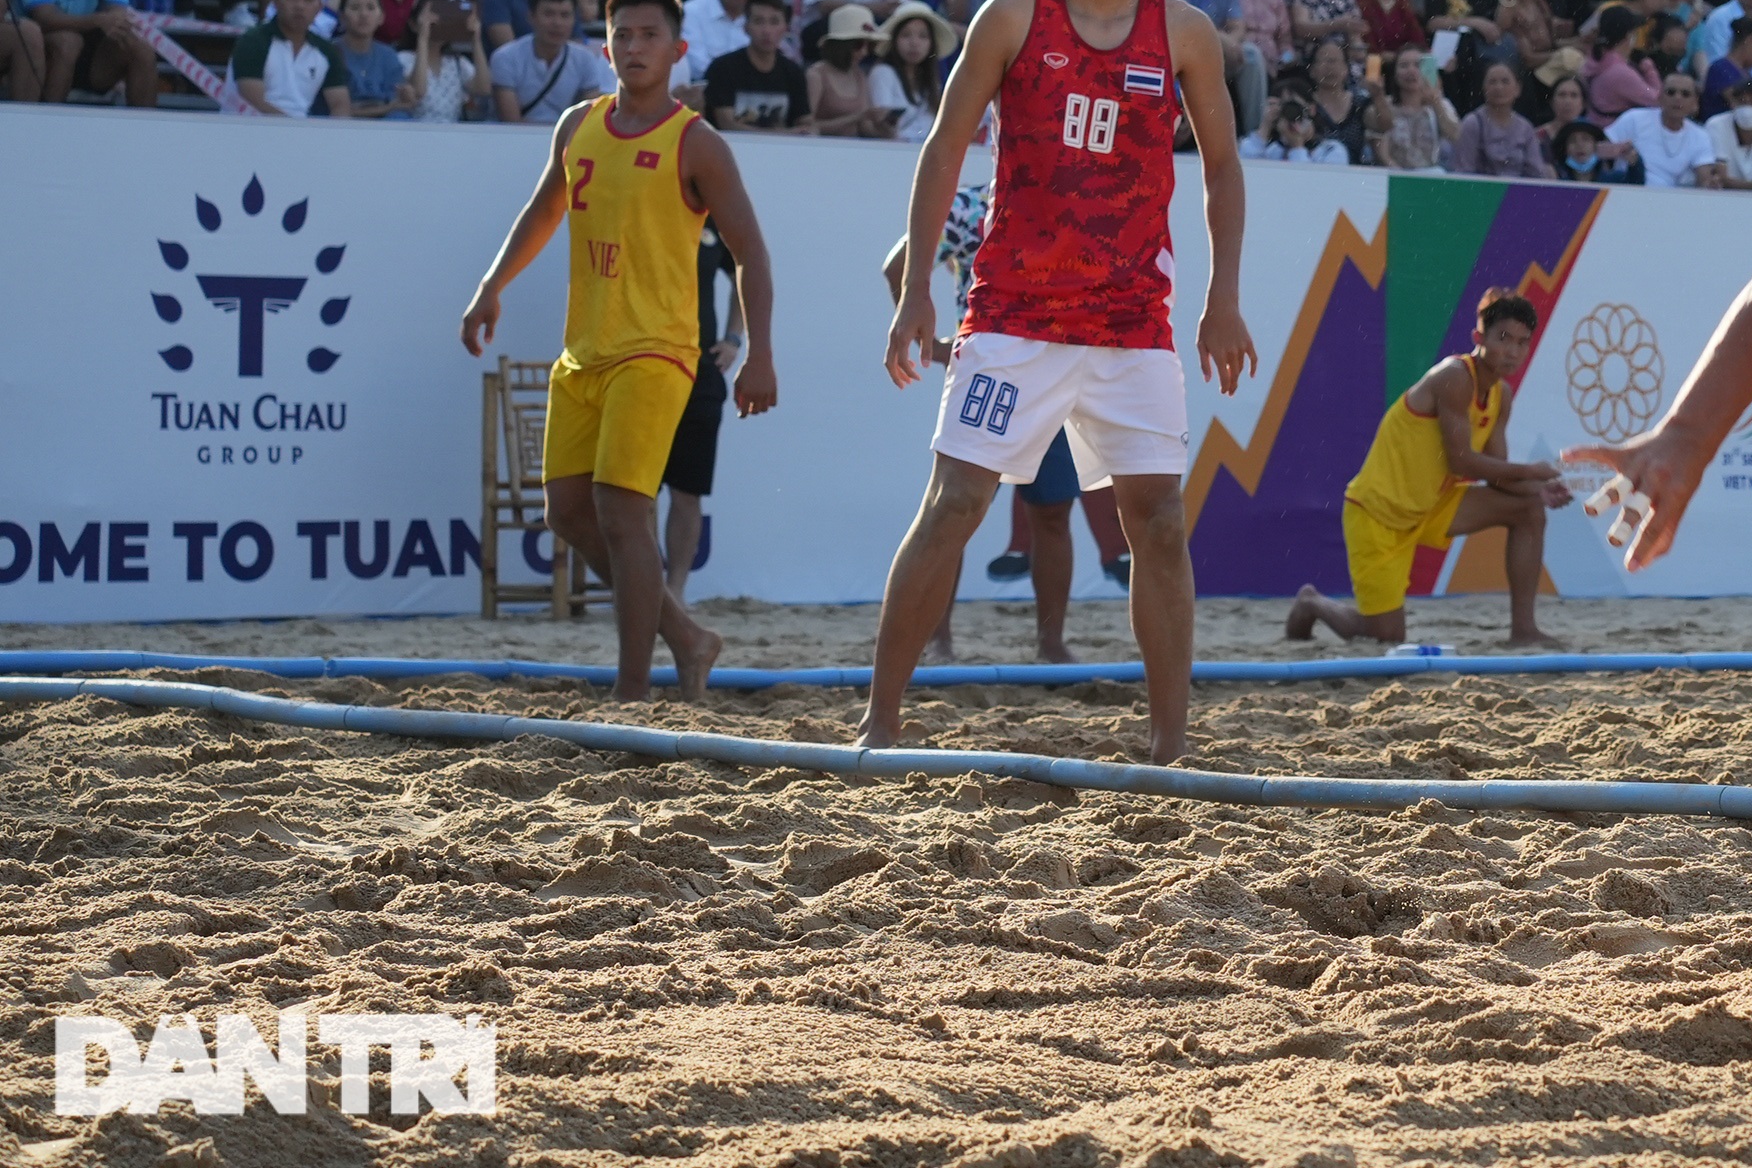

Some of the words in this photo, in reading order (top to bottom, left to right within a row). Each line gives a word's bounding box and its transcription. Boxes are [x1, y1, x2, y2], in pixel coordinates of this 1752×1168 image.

[1063, 93, 1120, 154] 88
[571, 158, 595, 210] 2
[587, 239, 620, 278] VIE
[151, 393, 240, 431] TUAN
[253, 392, 347, 431] CHAU
[959, 373, 1019, 436] 88
[197, 445, 303, 464] GROUP
[173, 520, 274, 583] TO
